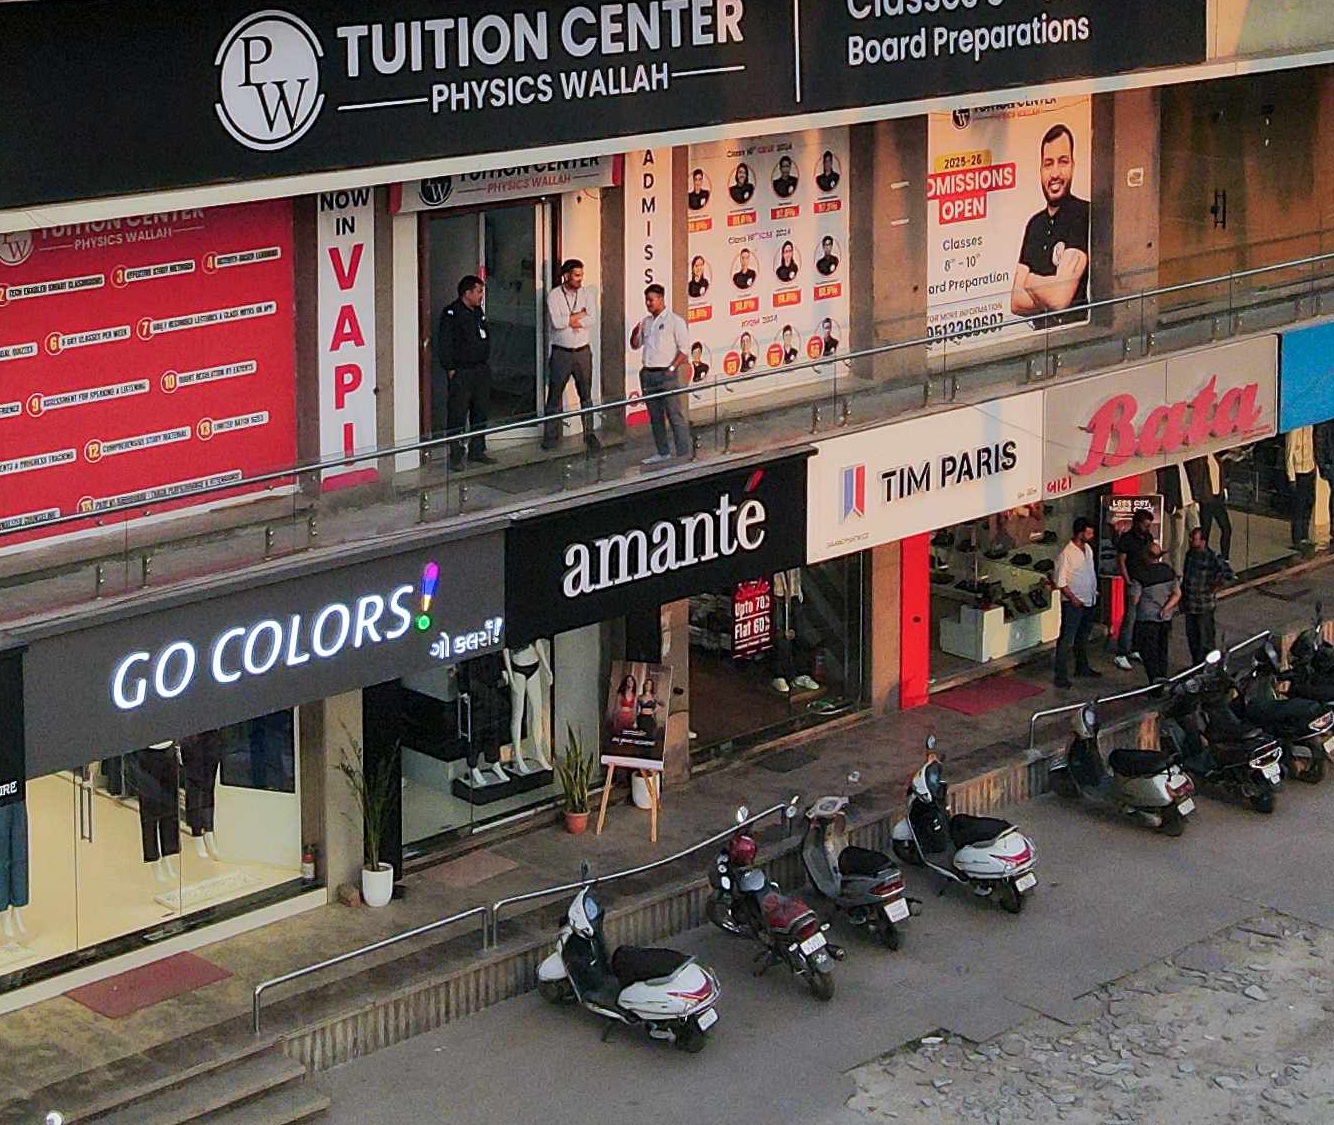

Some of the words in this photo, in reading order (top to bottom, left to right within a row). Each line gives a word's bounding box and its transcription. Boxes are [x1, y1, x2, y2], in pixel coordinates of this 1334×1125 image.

[337, 11, 548, 78] TUITION
[848, 27, 927, 67] Board
[933, 12, 1090, 62] Preparations
[432, 73, 554, 114] PHYSICS
[560, 62, 670, 101] WALLAH
[487, 175, 530, 194] PHYSICS
[320, 188, 370, 212] NOW
[942, 196, 985, 221] OPEN
[74, 232, 123, 251] PHYSICS
[125, 226, 173, 244] WALLAH
[336, 216, 355, 236] IN
[942, 236, 983, 252] Classes
[948, 271, 1009, 292] Preparation
[164, 375, 174, 389] 10
[1068, 375, 1264, 476] Bata
[881, 461, 931, 503] TIM
[940, 439, 1018, 488] PARIS
[563, 468, 766, 599] amanté
[111, 648, 196, 710] GO
